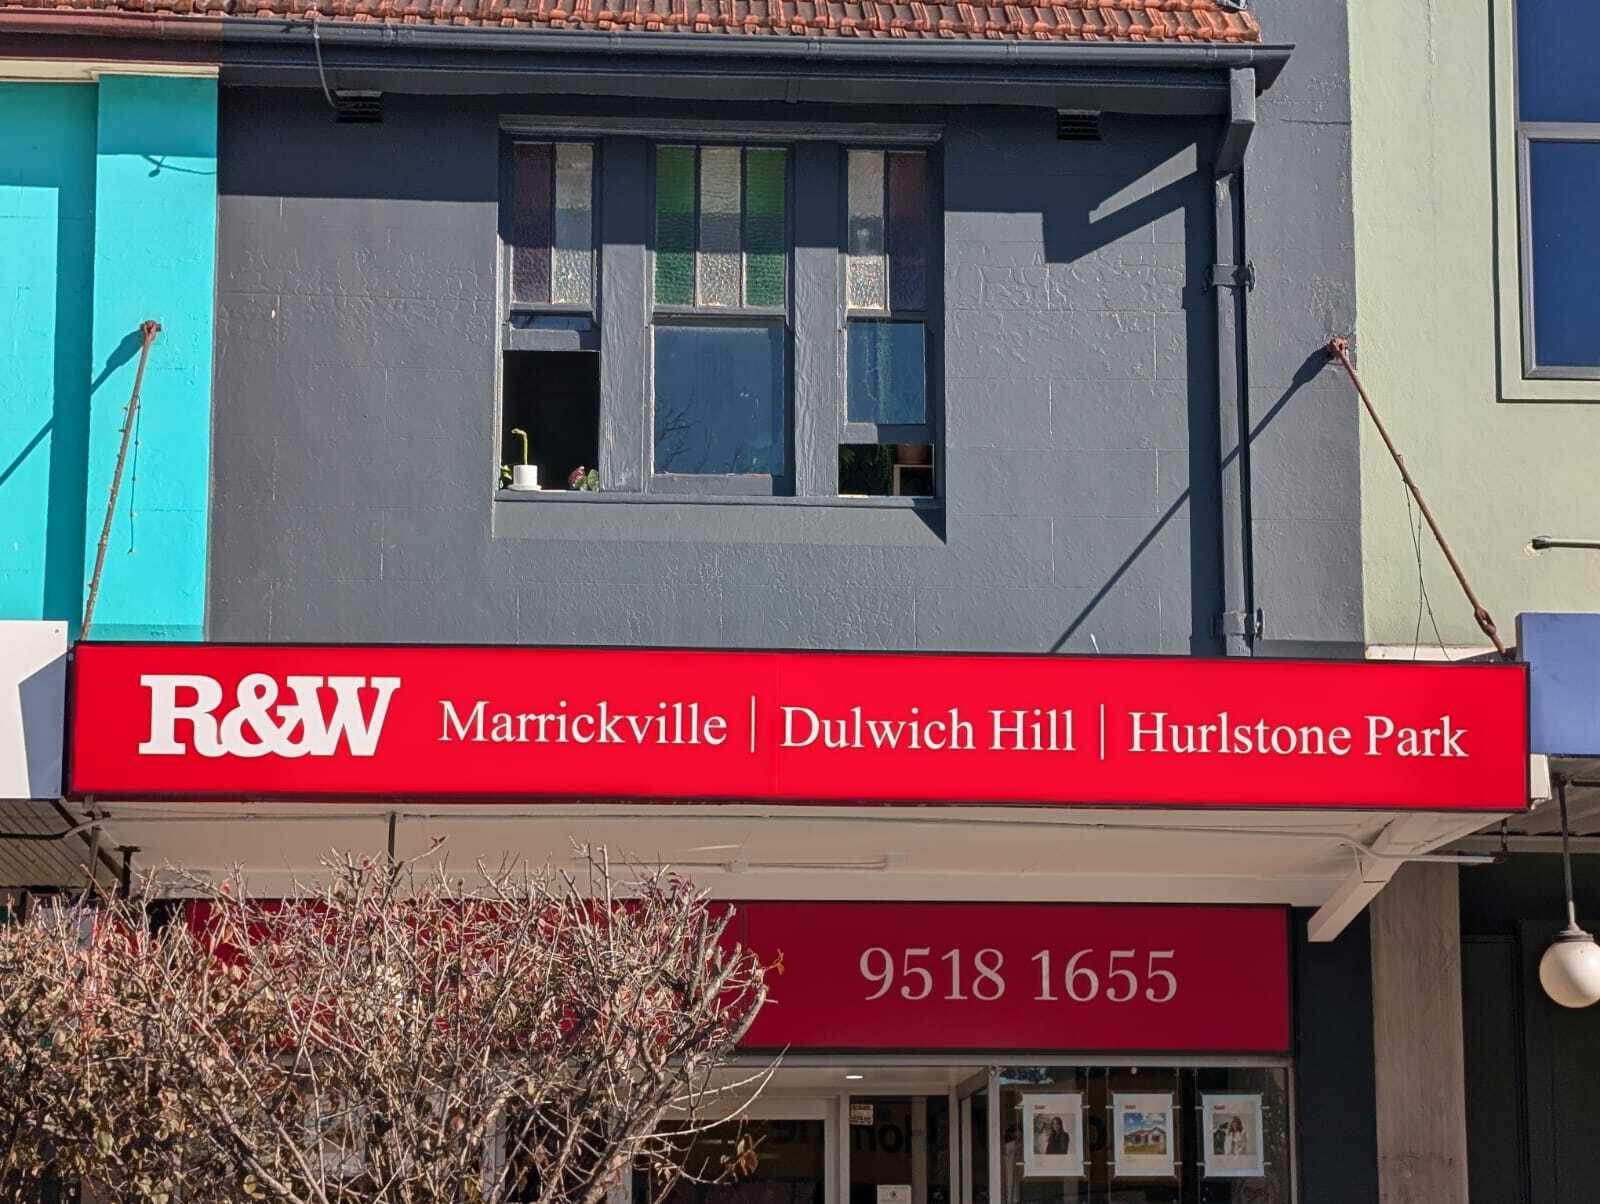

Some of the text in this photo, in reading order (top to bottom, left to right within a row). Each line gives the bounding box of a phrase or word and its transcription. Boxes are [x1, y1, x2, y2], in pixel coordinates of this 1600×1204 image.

[138, 672, 401, 758] R&W
[439, 699, 727, 746] Marrickville
[780, 705, 1076, 752] Dulwich Hill
[1128, 711, 1469, 758] Hurlstone Park
[859, 946, 1178, 1003] 9518 1655
